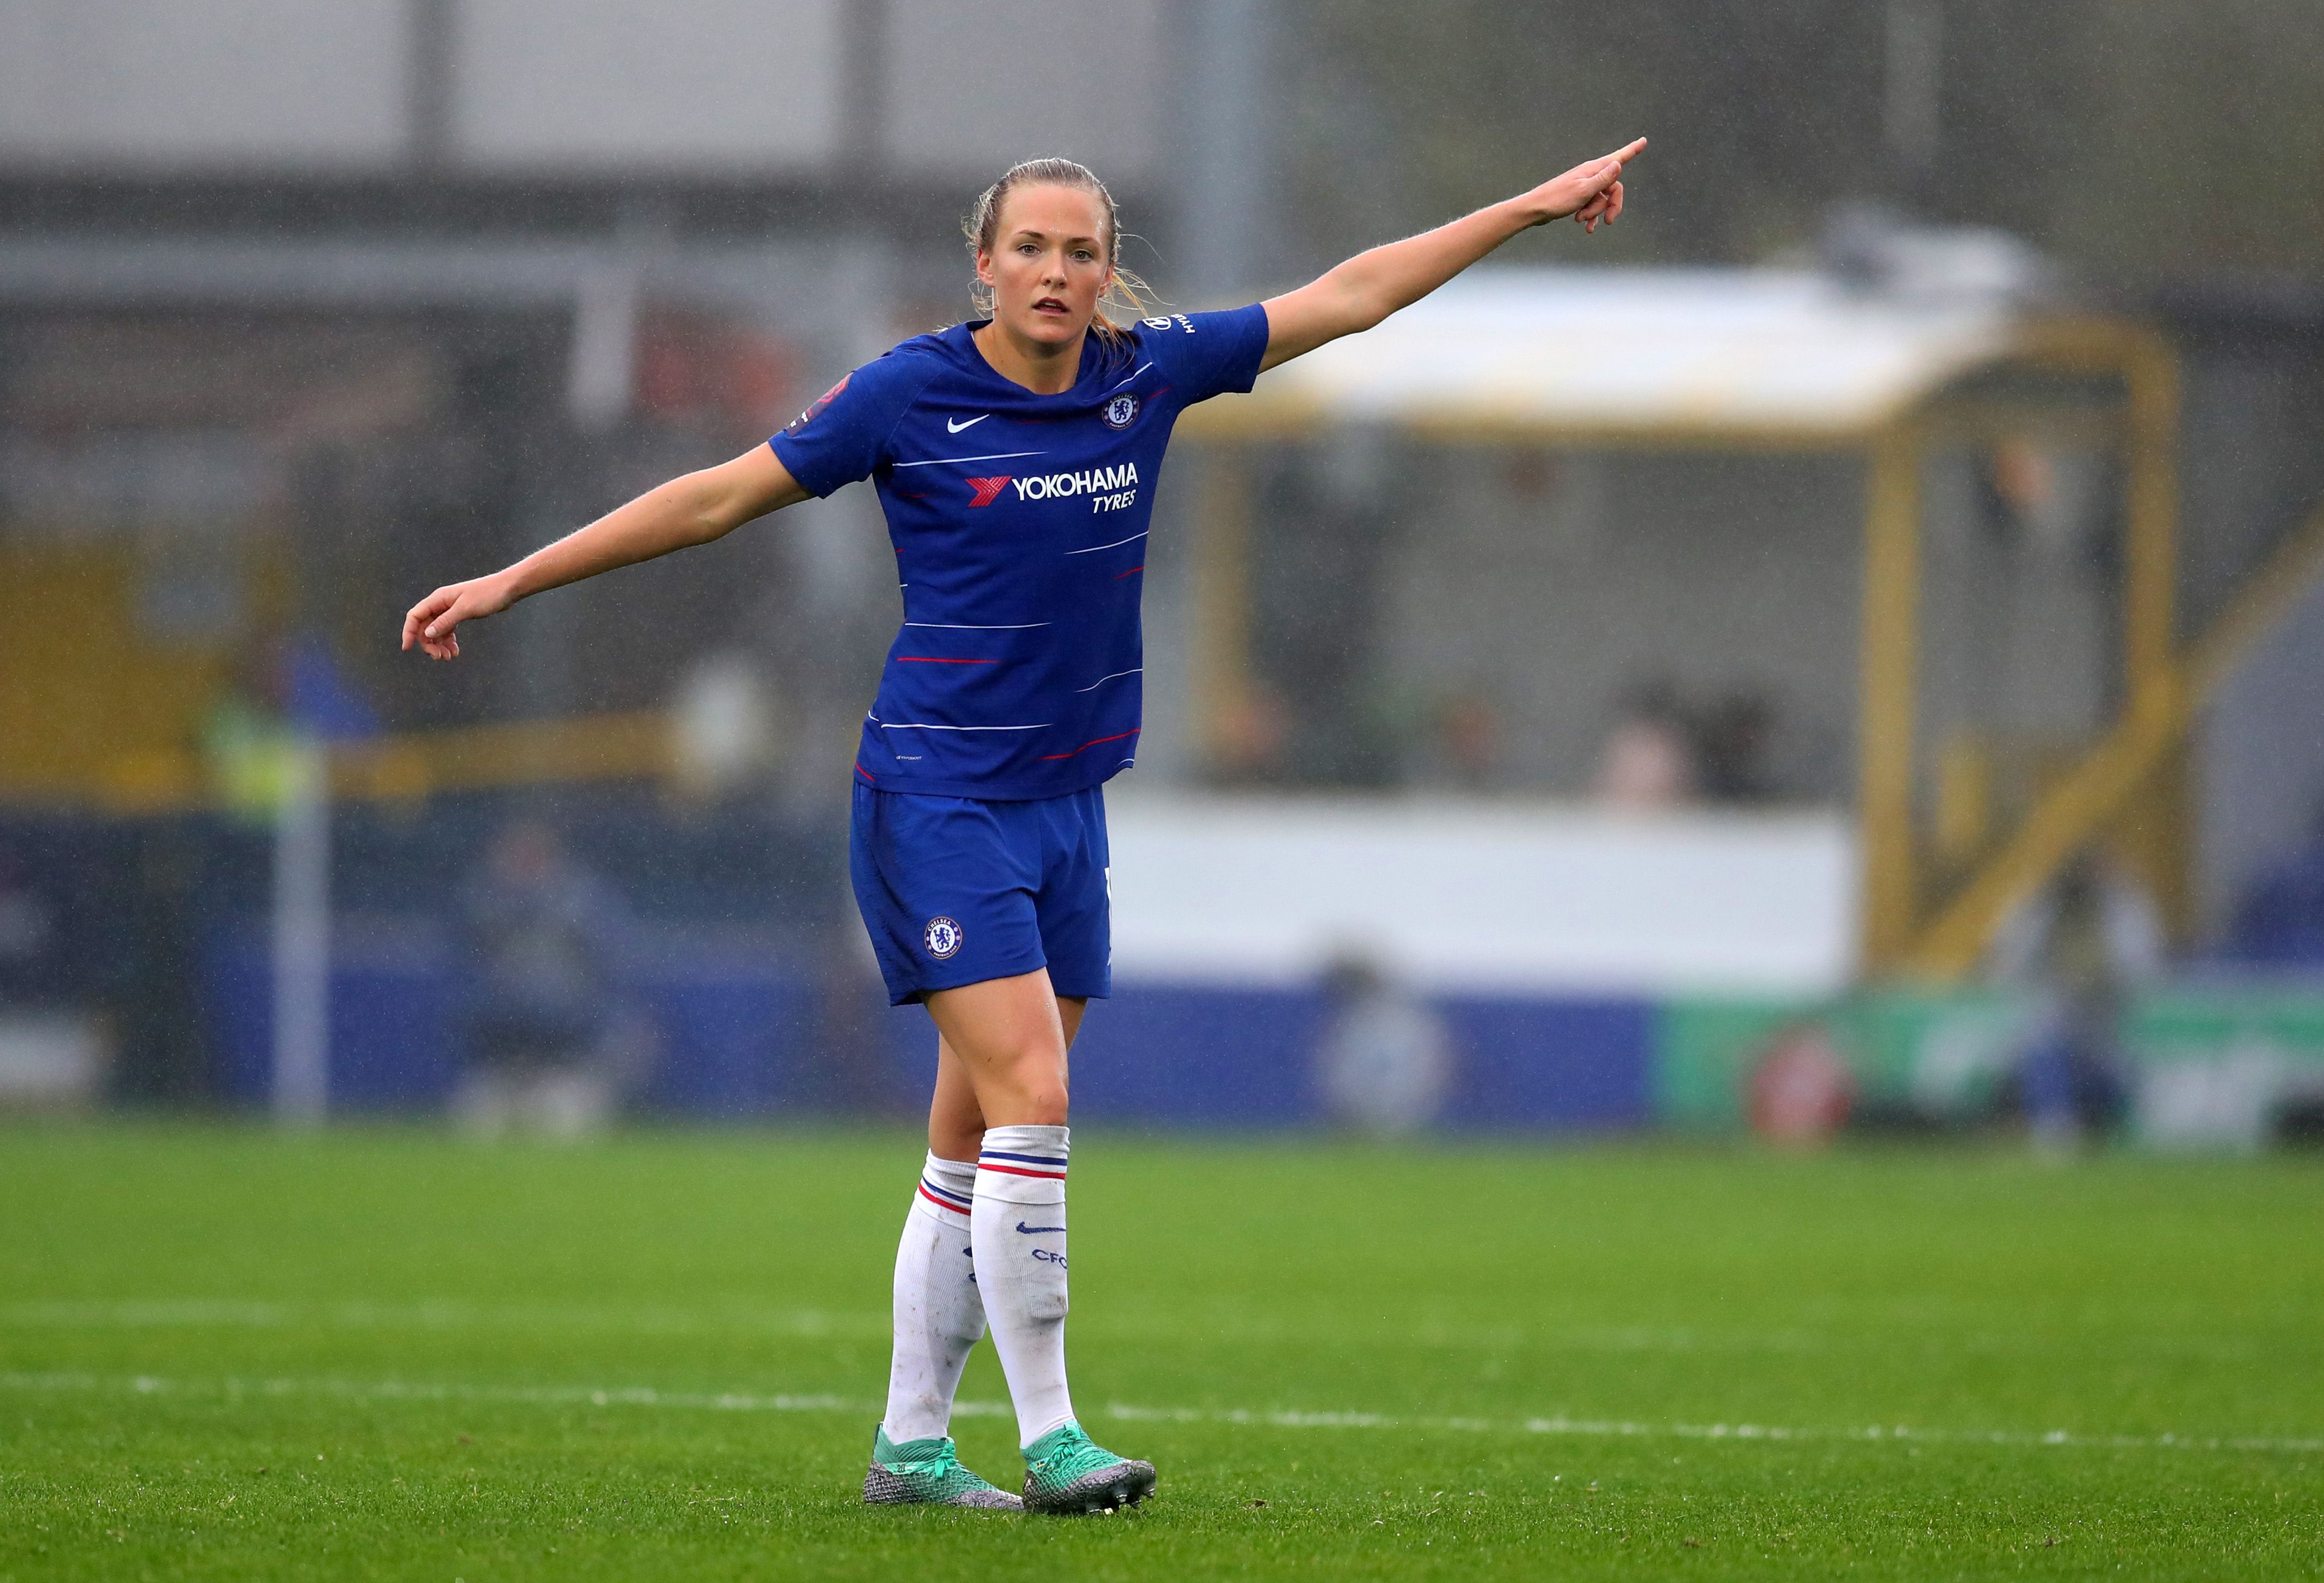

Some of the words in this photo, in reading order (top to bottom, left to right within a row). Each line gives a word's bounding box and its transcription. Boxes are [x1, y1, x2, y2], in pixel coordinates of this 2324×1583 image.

[1012, 459, 1138, 501] YOKOHAMA
[1093, 489, 1136, 513] TYRES
[928, 919, 950, 931] CHELSEA
